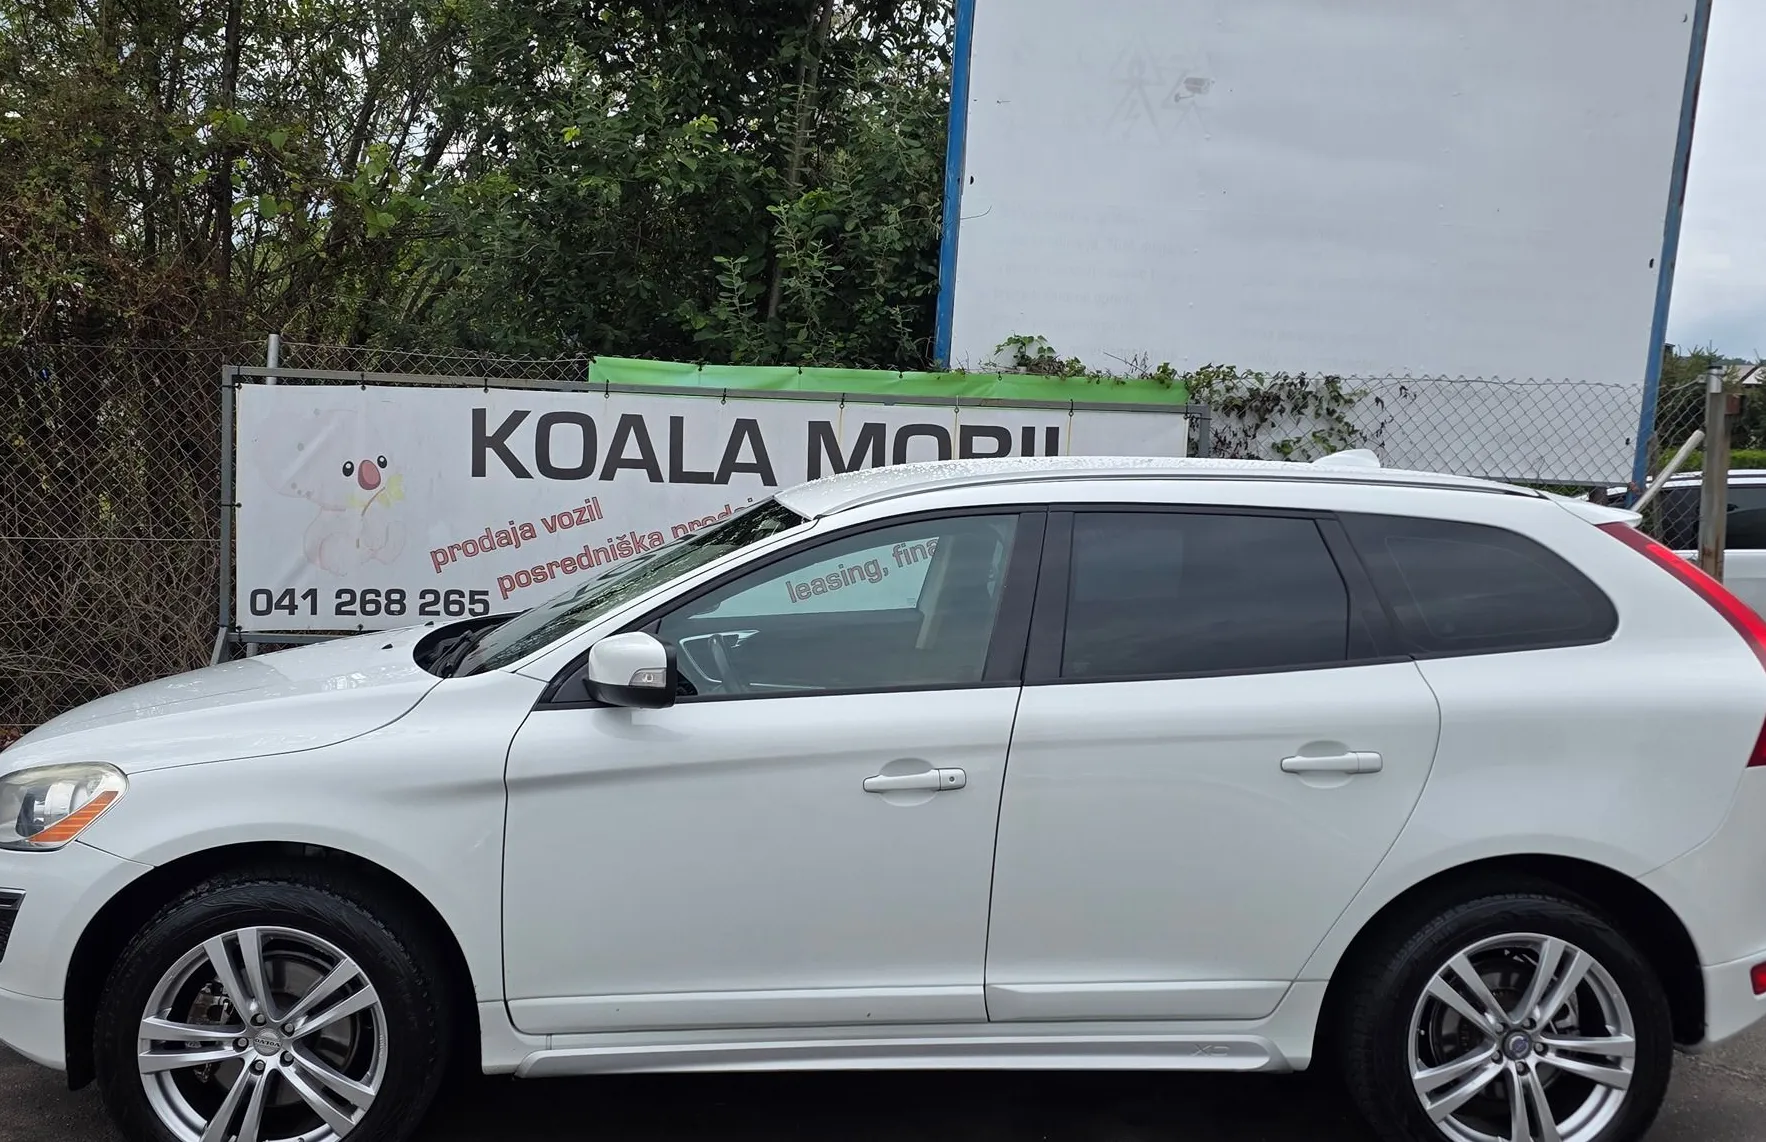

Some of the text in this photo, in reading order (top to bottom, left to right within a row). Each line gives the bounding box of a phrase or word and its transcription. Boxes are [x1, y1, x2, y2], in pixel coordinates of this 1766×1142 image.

[471, 407, 778, 486] KOALA
[430, 496, 604, 574] prodaja vozil
[496, 531, 666, 601] posredniška
[249, 588, 490, 617] 041 268 265
[785, 558, 889, 604] leasing,
